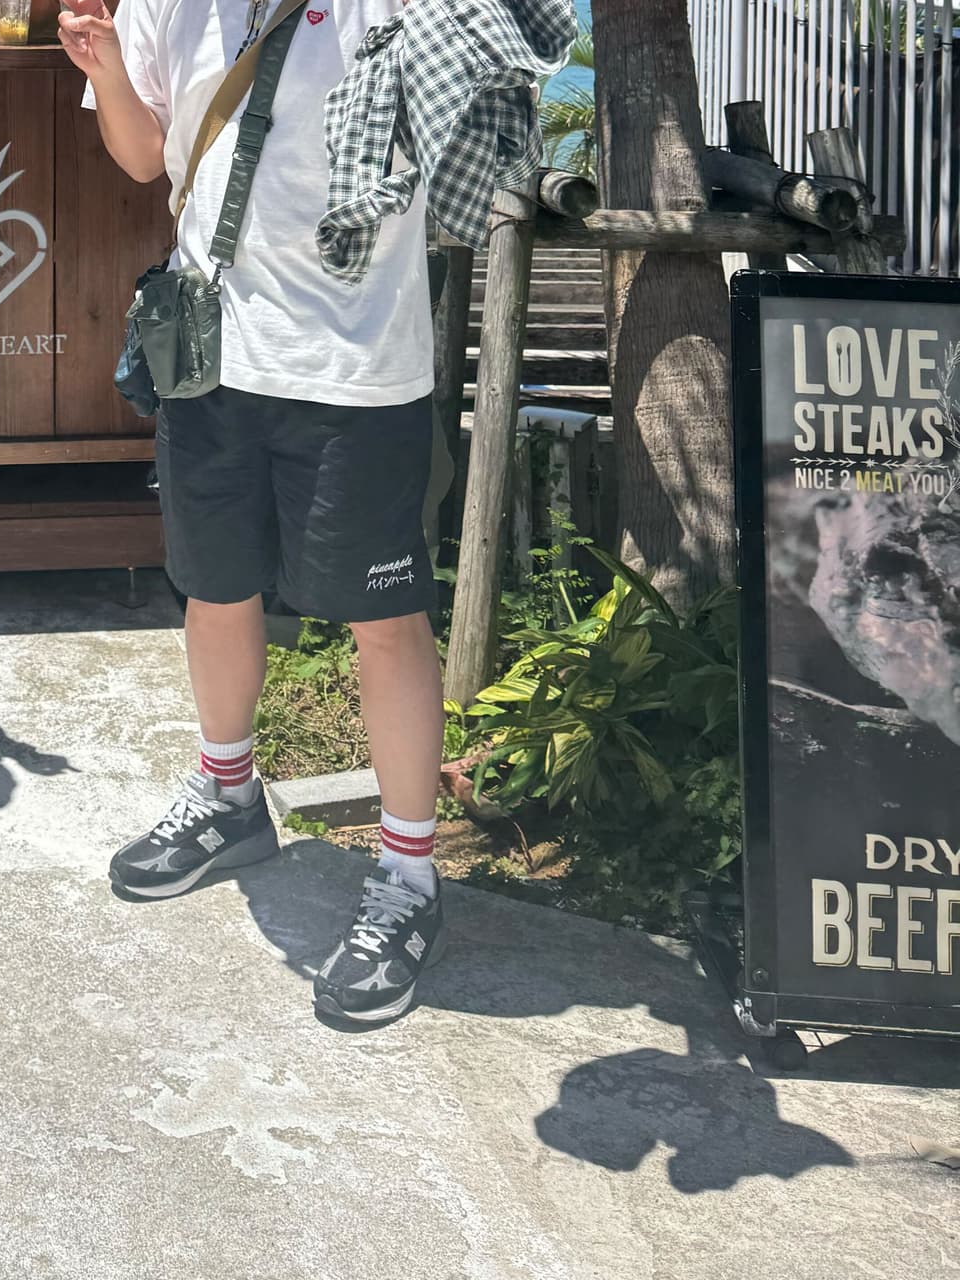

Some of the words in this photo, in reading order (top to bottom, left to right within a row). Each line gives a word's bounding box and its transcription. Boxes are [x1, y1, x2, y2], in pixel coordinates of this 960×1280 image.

[793, 324, 941, 400] LOVE
[793, 401, 944, 458] STEAKS
[794, 467, 836, 491] NICE
[839, 471, 851, 491] 2
[855, 470, 904, 494] MEAT
[909, 473, 945, 496] YOU
[368, 554, 413, 578] pineapple
[366, 571, 415, 591] パインハート
